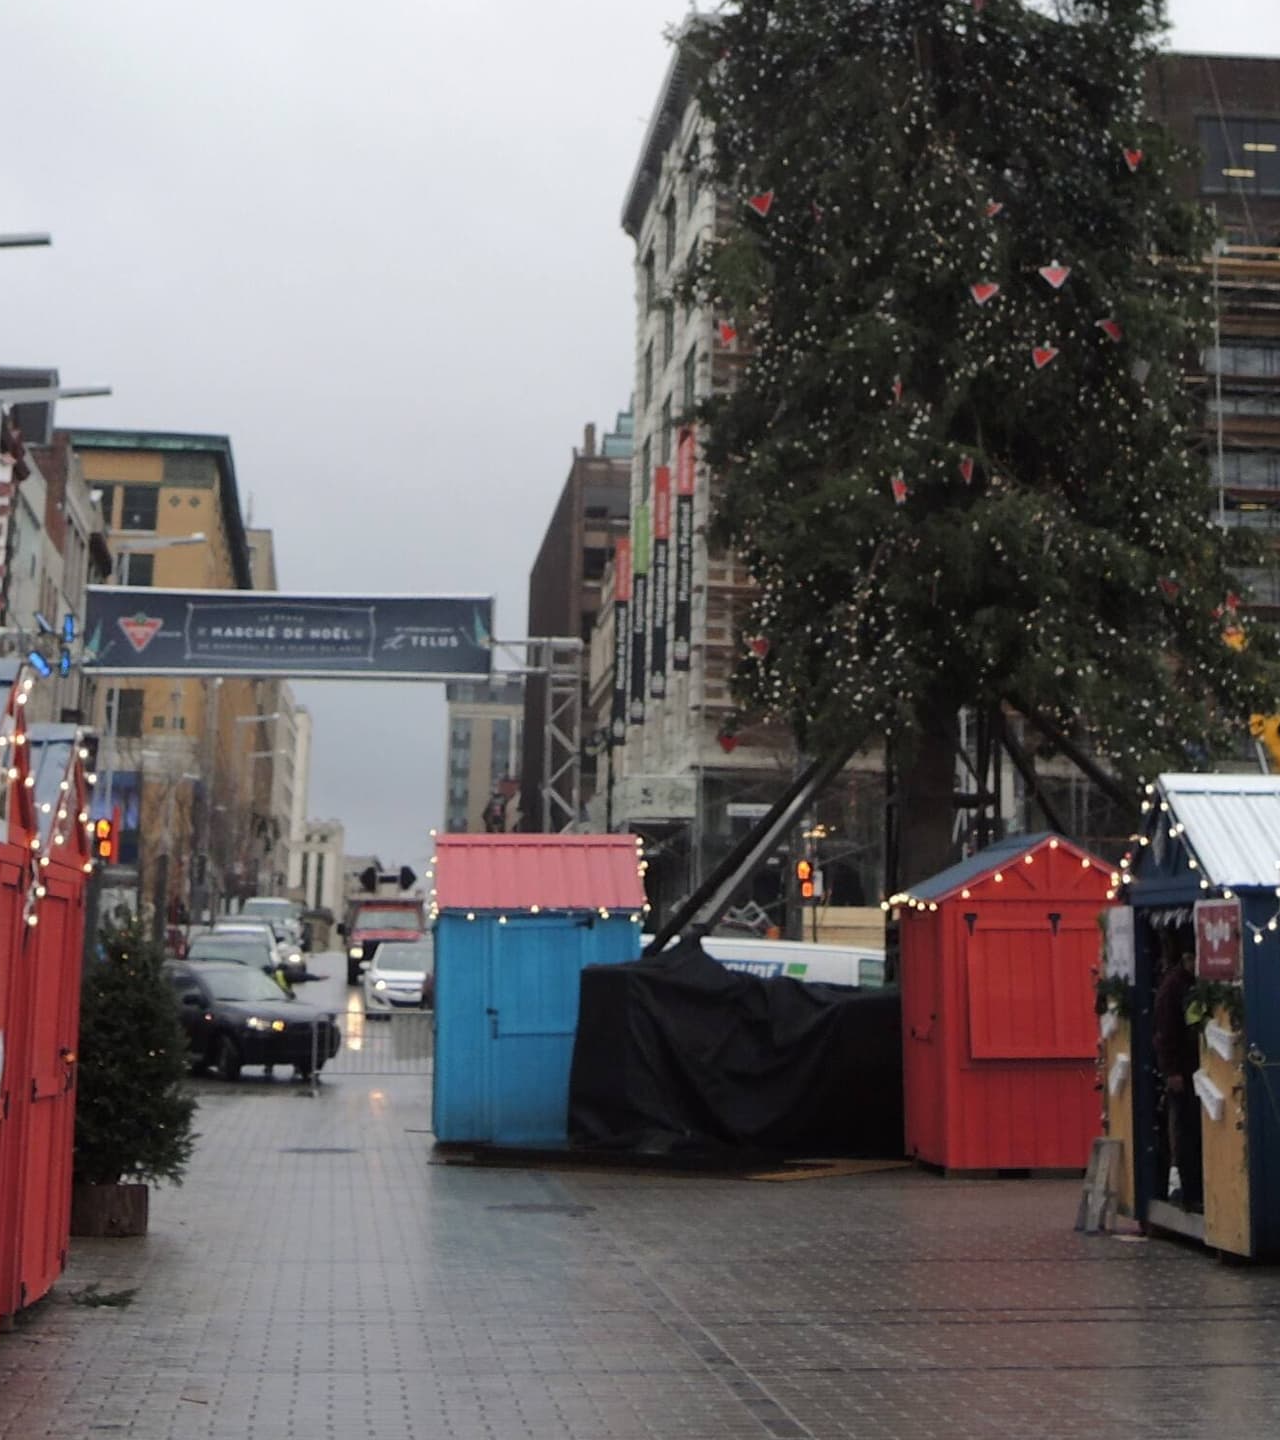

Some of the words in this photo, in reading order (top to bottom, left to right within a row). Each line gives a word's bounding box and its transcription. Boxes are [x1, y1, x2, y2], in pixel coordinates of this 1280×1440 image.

[211, 625, 276, 639] MARCHÉ
[283, 627, 303, 640] DE
[310, 627, 352, 641] NOËL
[411, 635, 458, 648] TELUS
